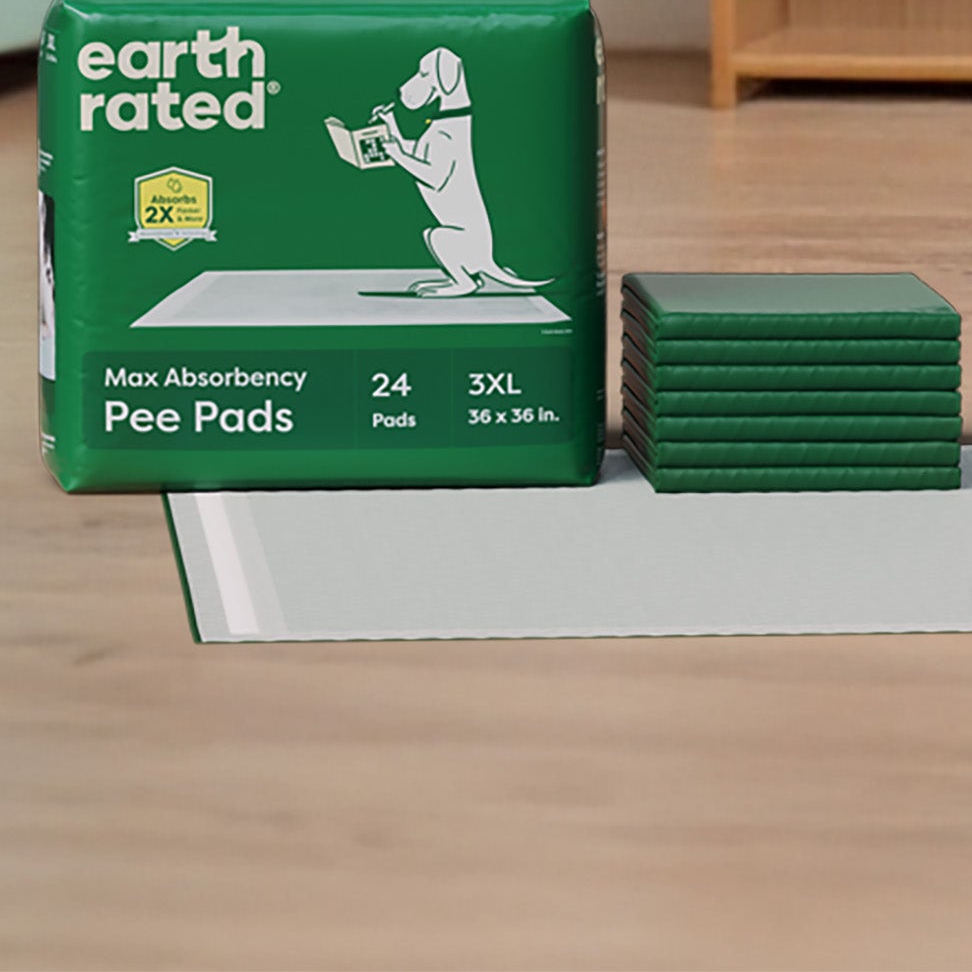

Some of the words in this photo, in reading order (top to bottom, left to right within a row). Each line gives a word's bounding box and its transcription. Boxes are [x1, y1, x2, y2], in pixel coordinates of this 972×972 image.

[78, 26, 265, 79] earth
[151, 195, 197, 204] Absorbs
[145, 206, 174, 223] 2X
[105, 367, 159, 387] Max
[164, 367, 308, 392] Absorbency
[371, 372, 412, 397] 24
[468, 373, 522, 395] 3XL
[105, 400, 181, 433] Pee
[195, 399, 294, 433] Pads
[372, 412, 417, 428] Pads
[468, 409, 492, 424] 36
[495, 411, 508, 424] x
[511, 407, 535, 423] 36
[538, 406, 560, 422] in.
